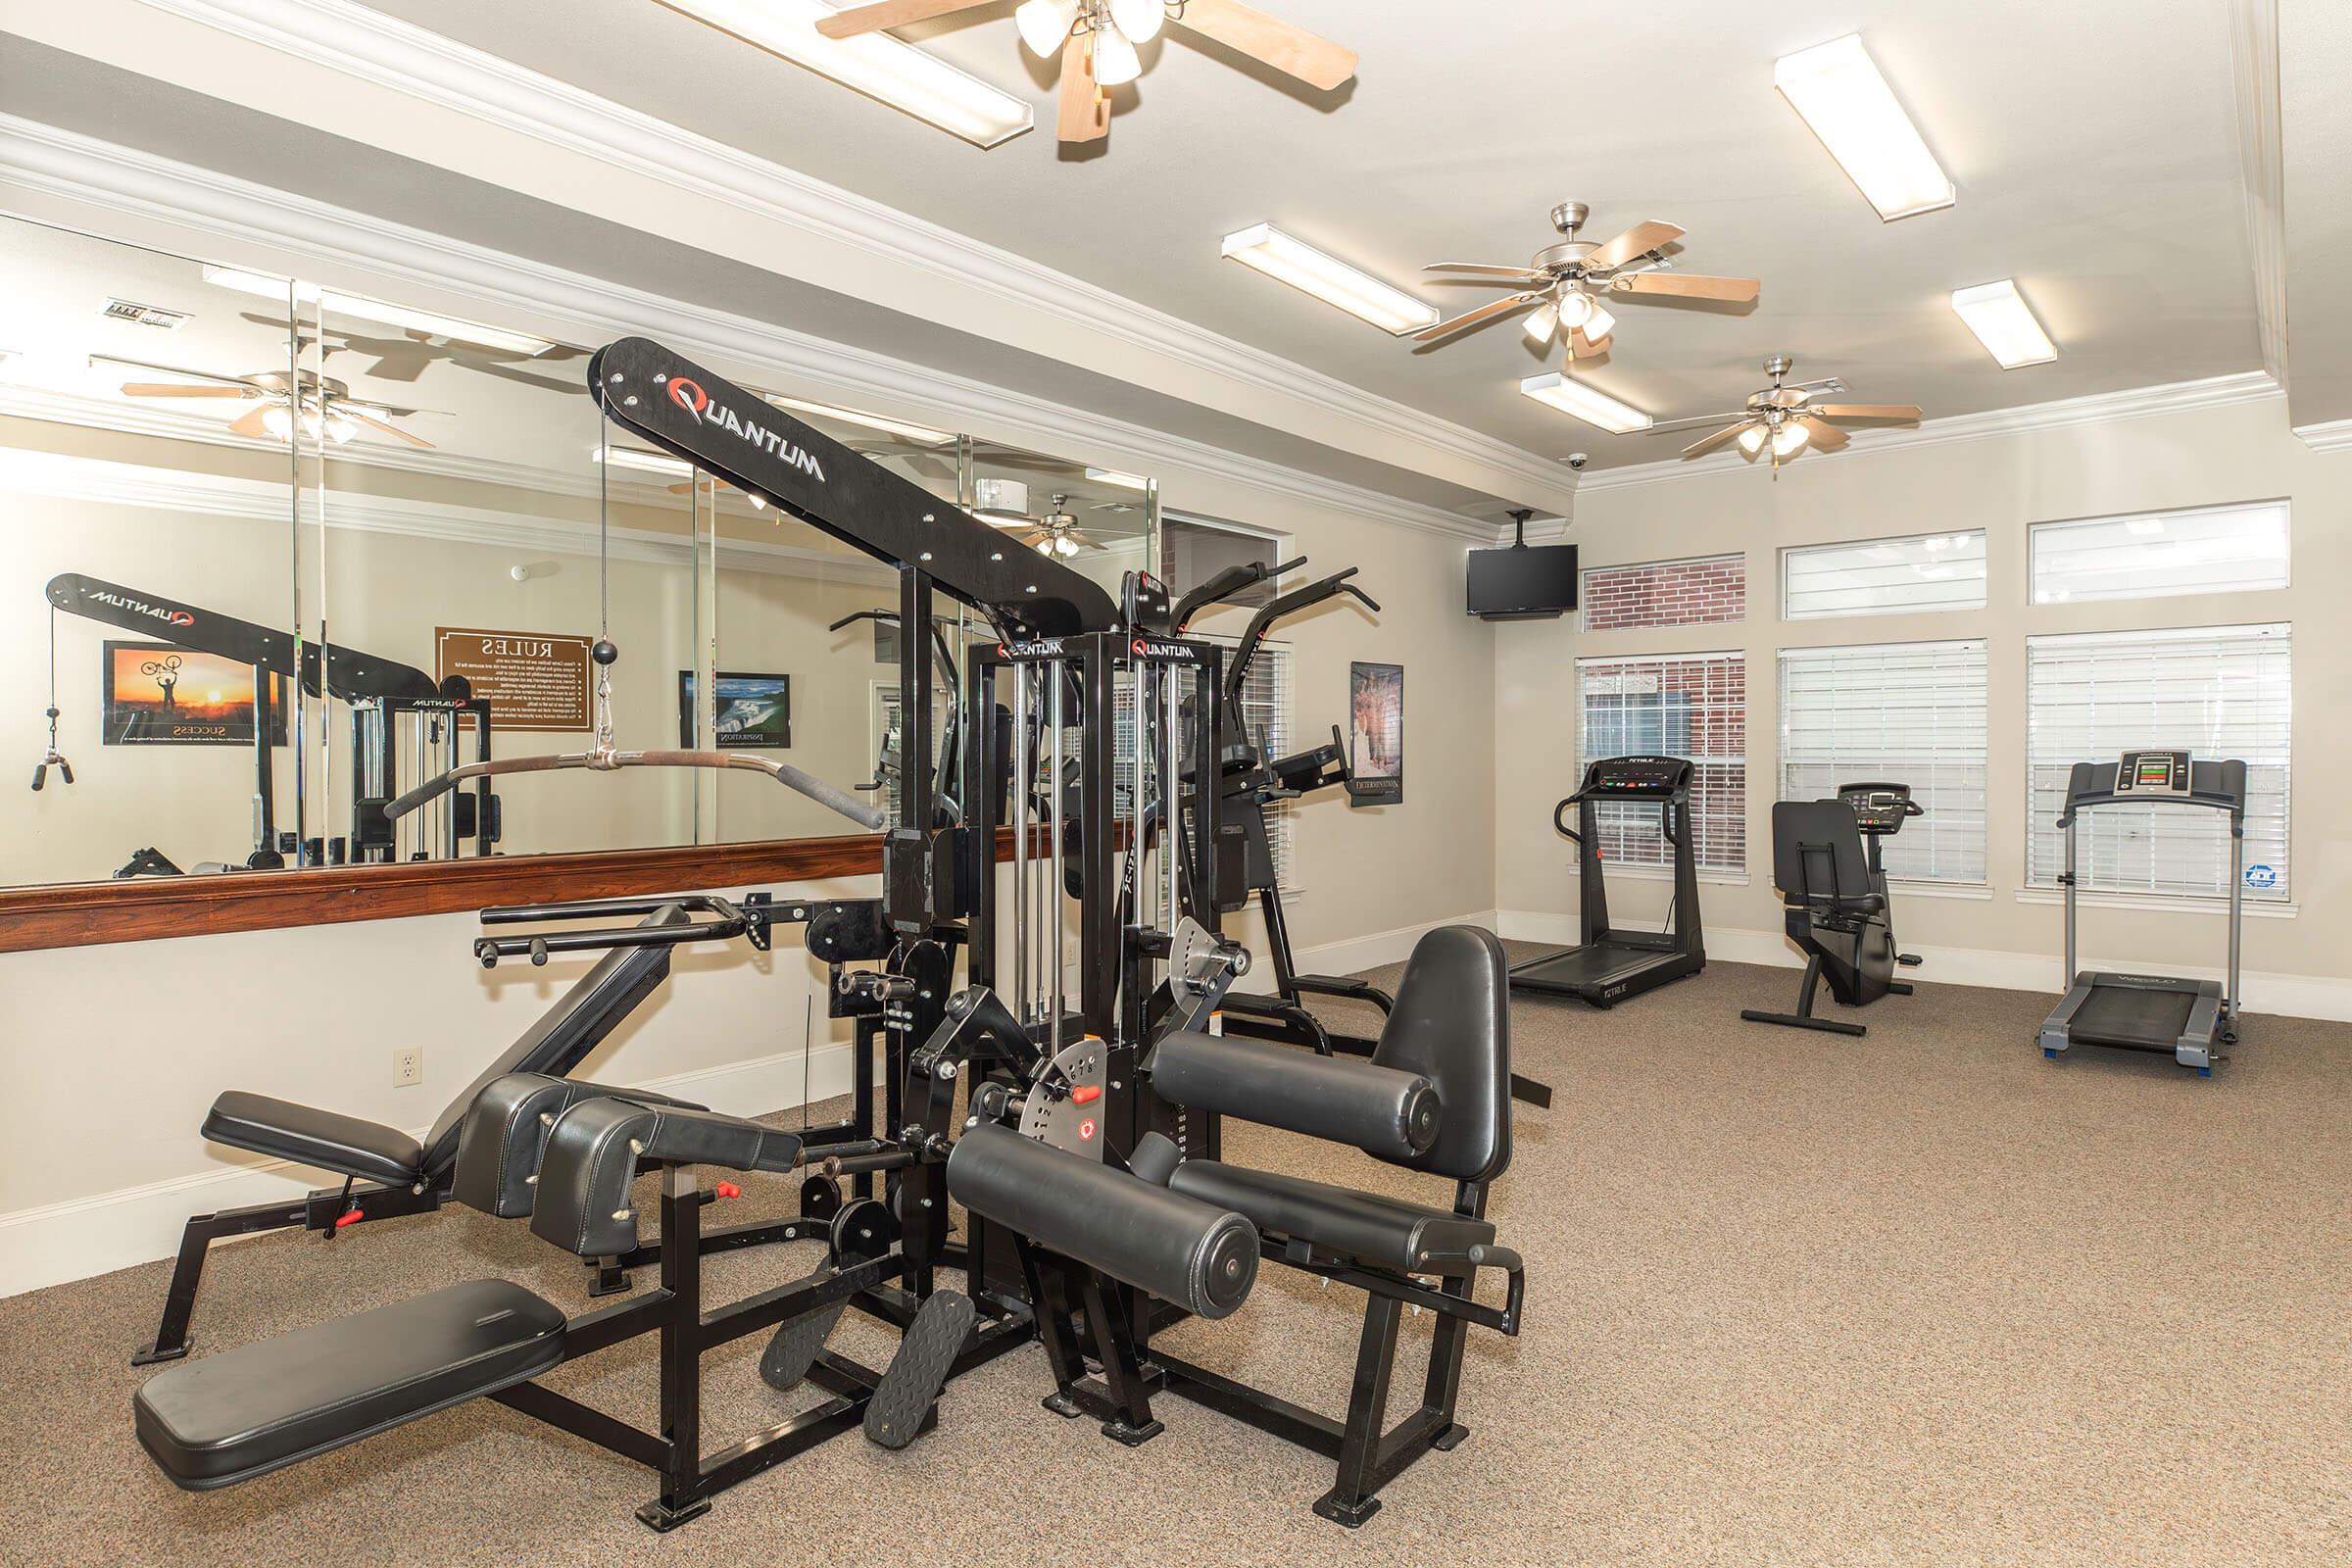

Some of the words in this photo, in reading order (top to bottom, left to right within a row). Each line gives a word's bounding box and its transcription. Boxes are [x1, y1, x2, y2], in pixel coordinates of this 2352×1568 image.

[666, 377, 825, 483] QUANTUM
[997, 642, 1064, 661] QNTUM
[1132, 639, 1195, 659] QUANTUM
[2247, 870, 2275, 880] ADT
[1079, 1066, 1084, 1076] 7
[1044, 1108, 1052, 1117] 2
